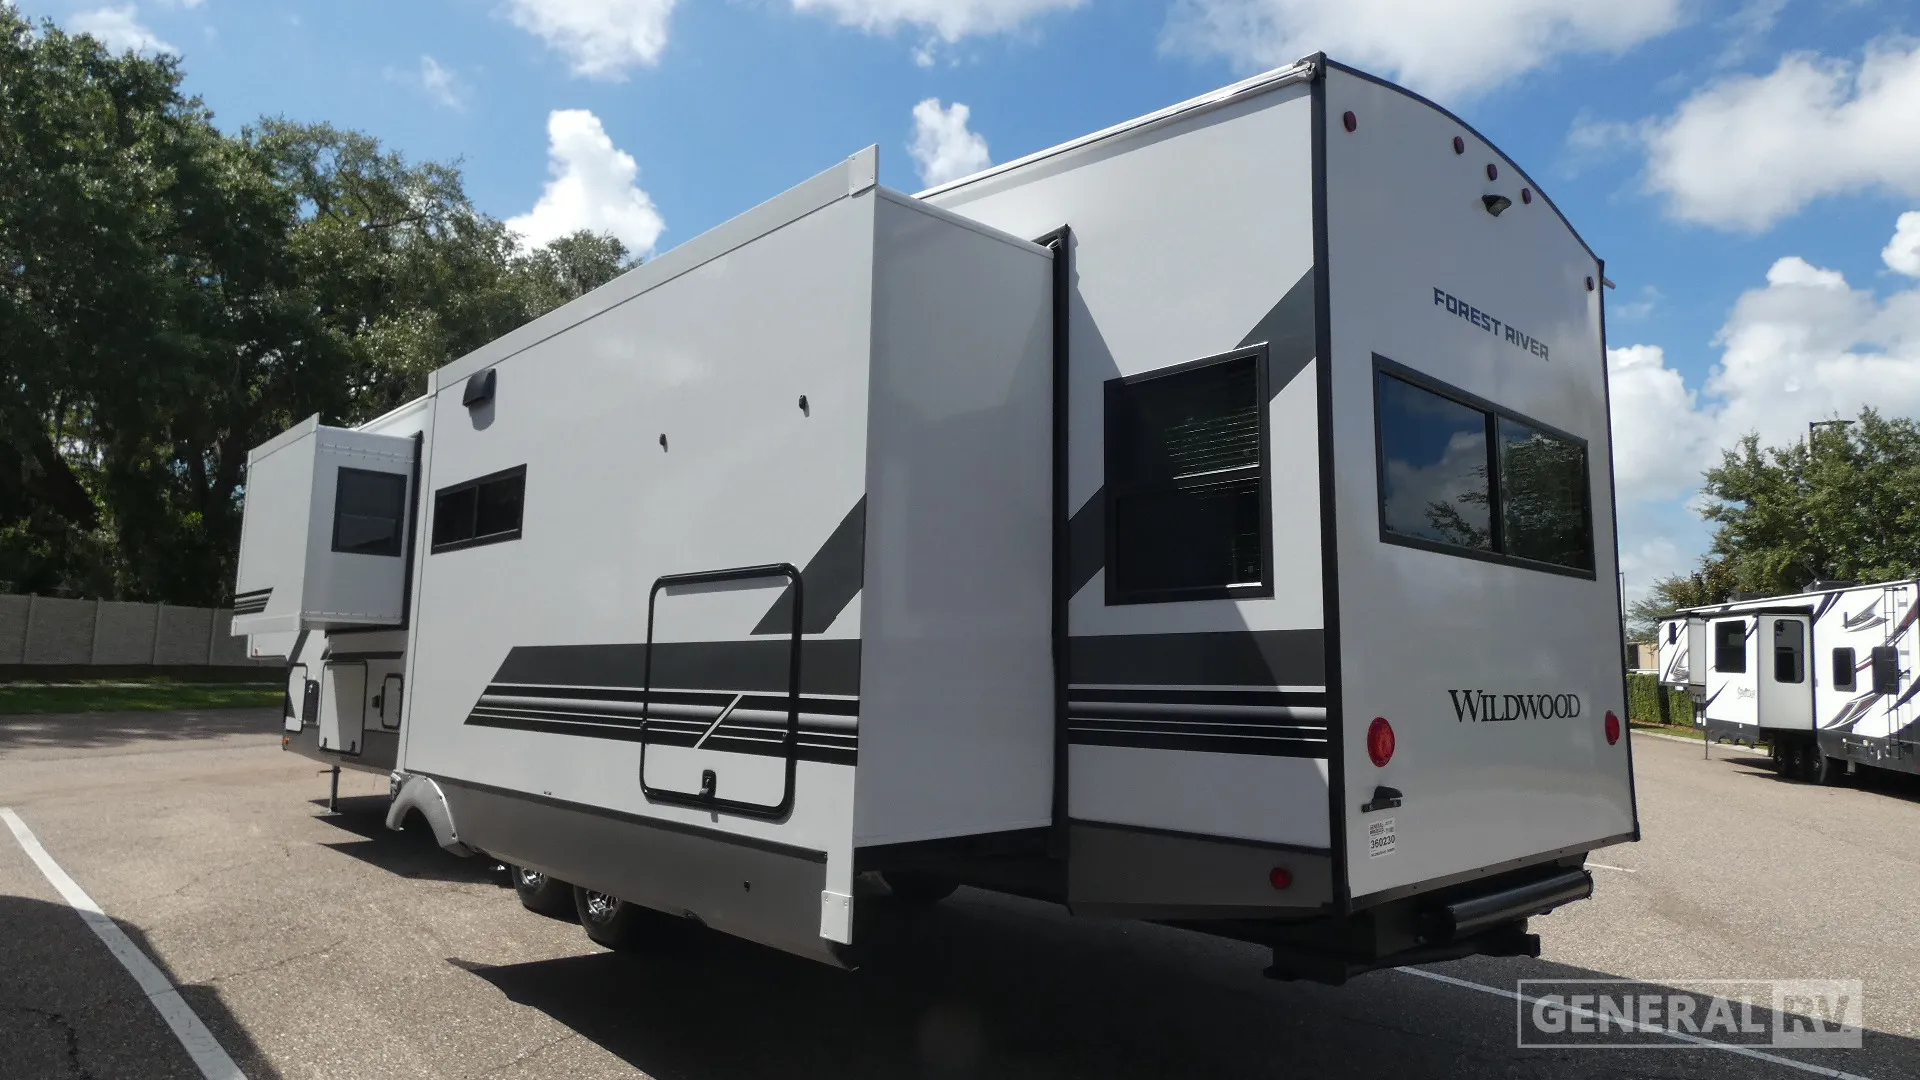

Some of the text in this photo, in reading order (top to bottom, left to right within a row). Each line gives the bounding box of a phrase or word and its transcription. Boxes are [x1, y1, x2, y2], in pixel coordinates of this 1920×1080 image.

[1433, 286, 1549, 361] FOREST RIVER
[1370, 835, 1396, 849] 360230
